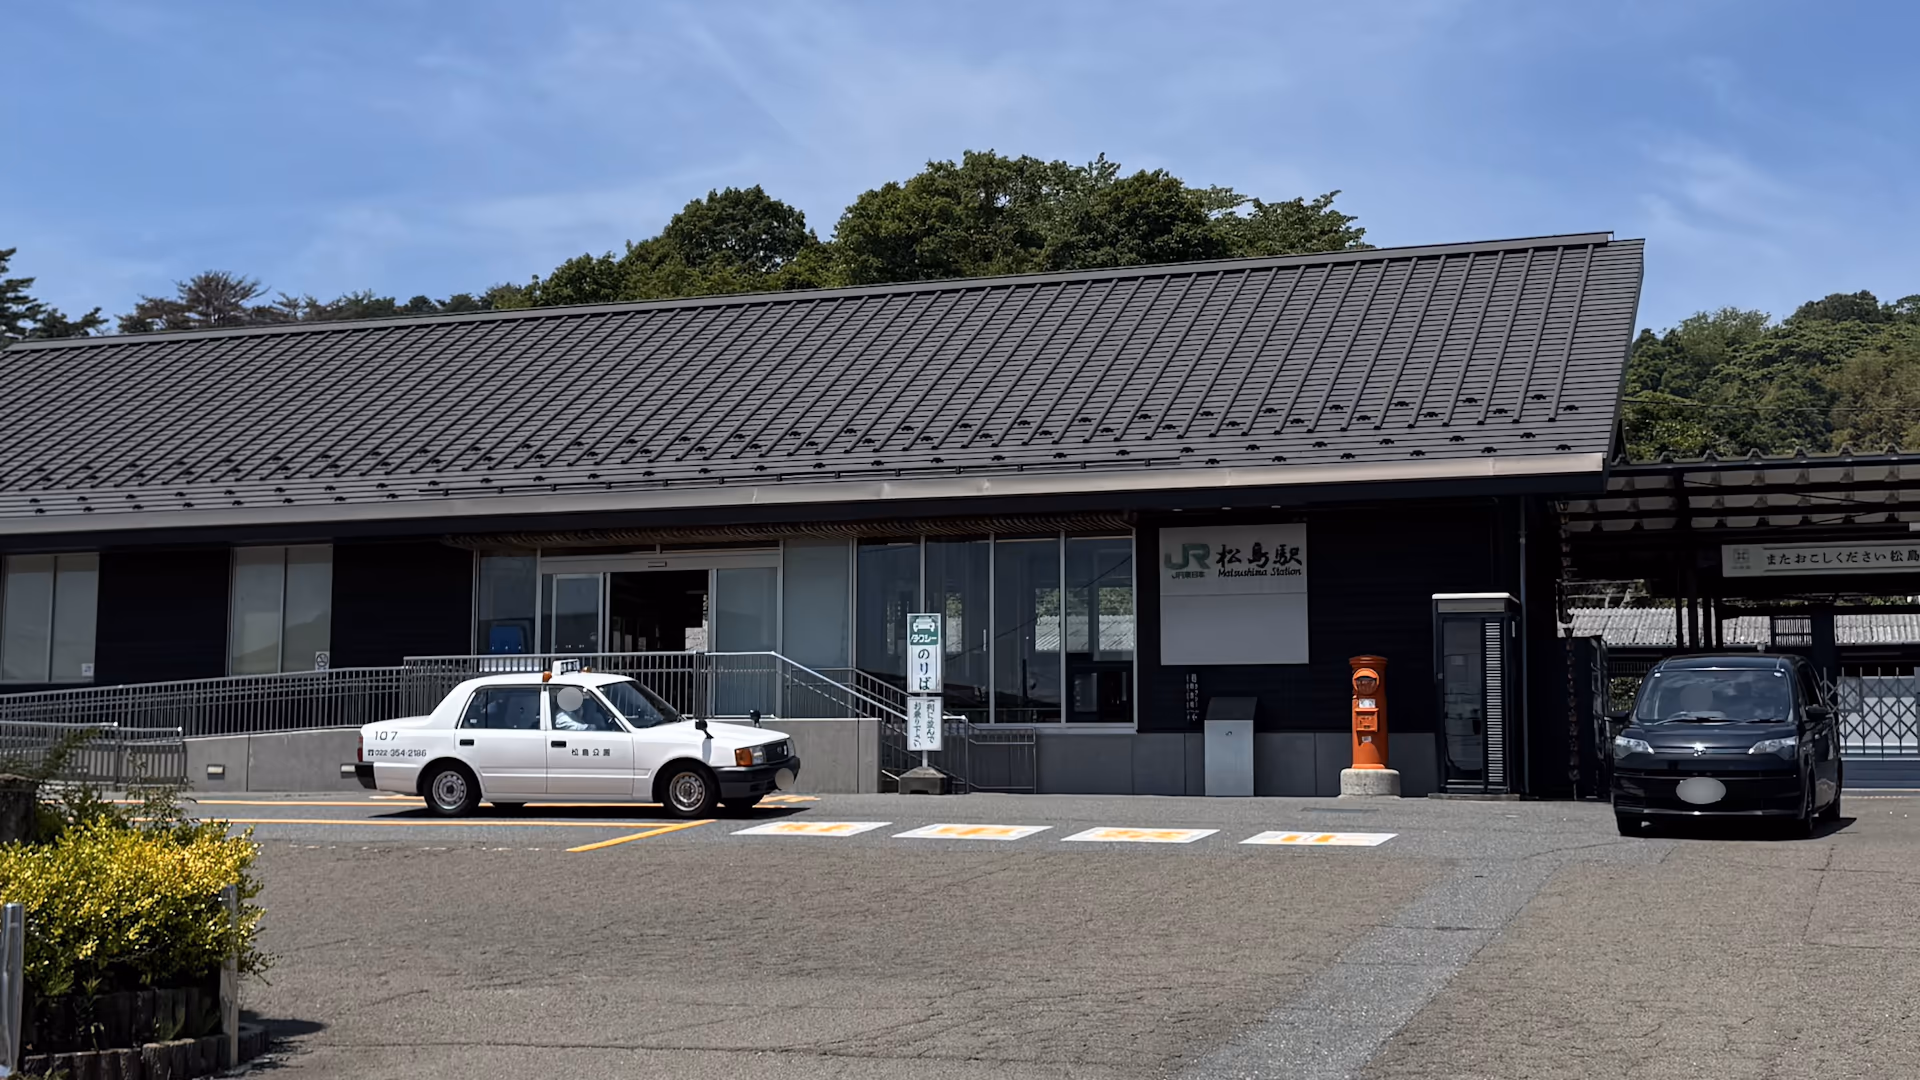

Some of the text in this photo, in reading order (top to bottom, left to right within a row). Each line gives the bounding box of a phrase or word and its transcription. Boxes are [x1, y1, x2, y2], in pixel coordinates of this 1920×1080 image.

[1164, 543, 1210, 570] JR
[1216, 542, 1302, 569] 松島駅
[1218, 566, 1302, 578] Matsushima Station
[911, 634, 937, 643] タクシー
[918, 648, 931, 691] のりば
[375, 731, 398, 741] 107
